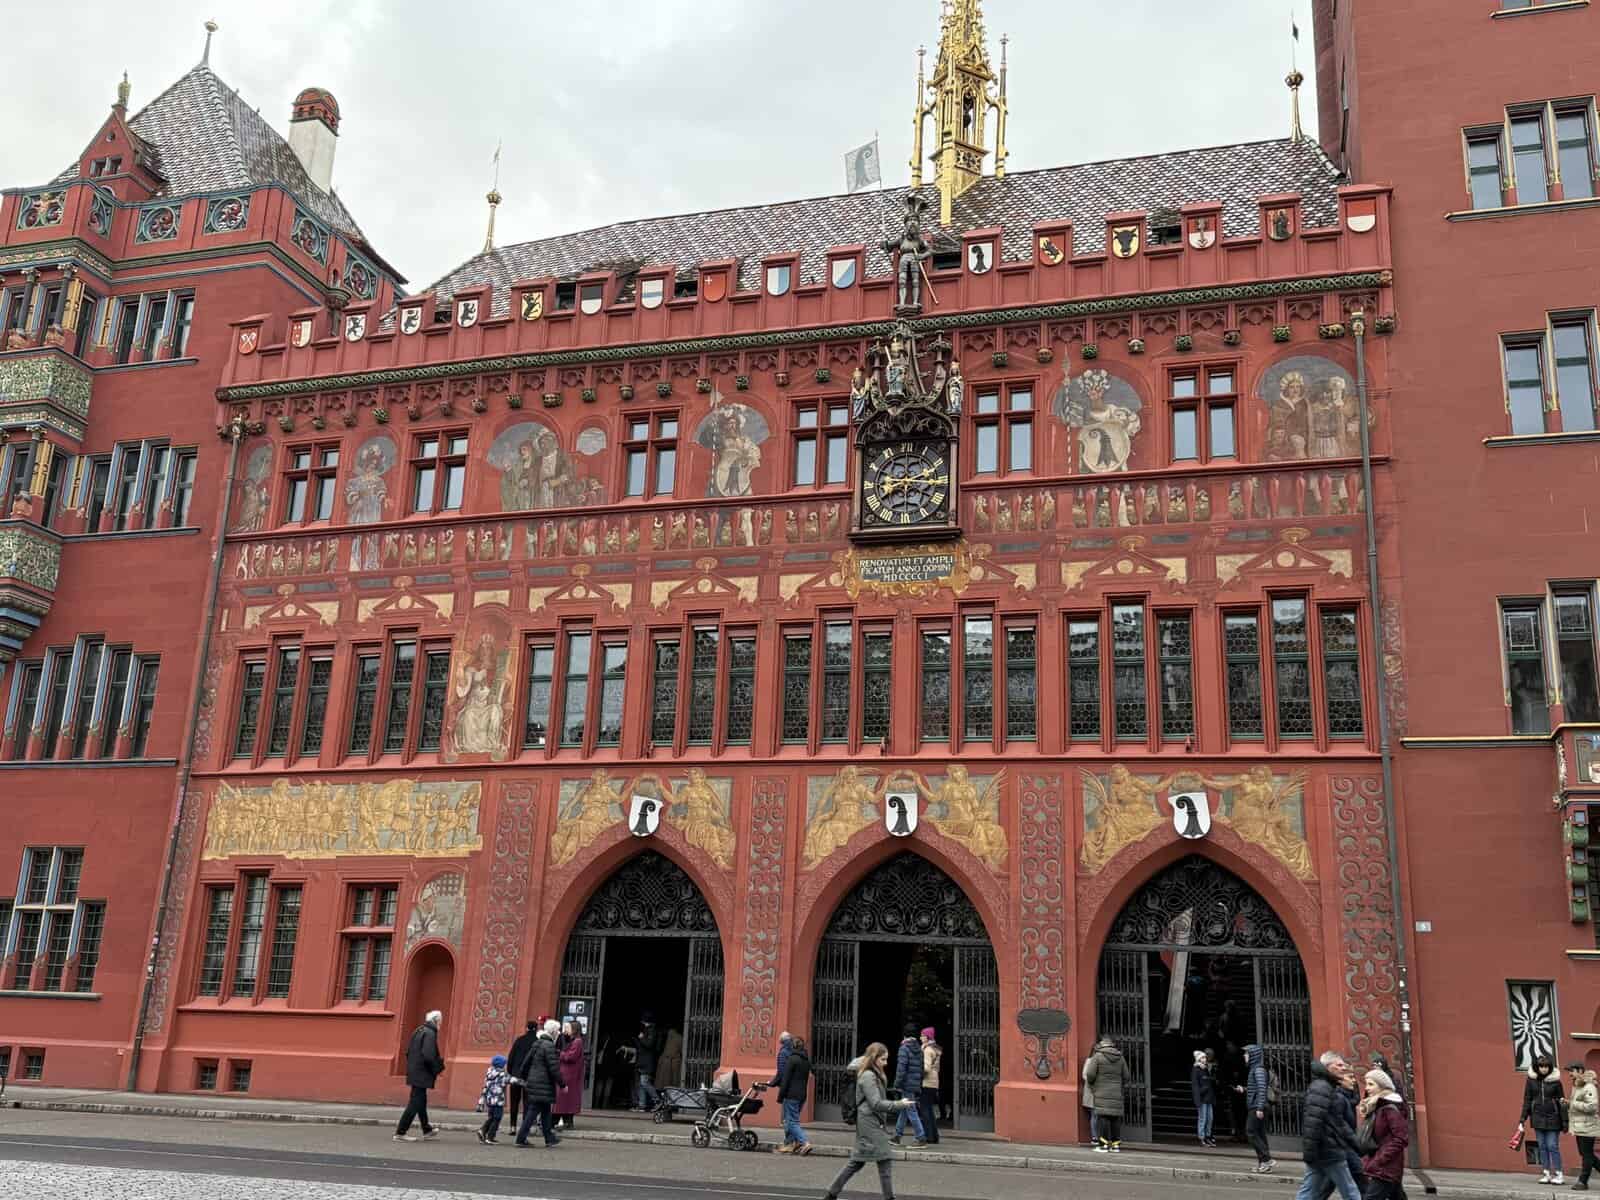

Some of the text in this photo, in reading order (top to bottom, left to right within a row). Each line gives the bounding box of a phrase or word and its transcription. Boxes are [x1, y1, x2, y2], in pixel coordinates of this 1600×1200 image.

[859, 555, 953, 568] RENOVATUM ET AMPLI
[896, 565, 921, 574] ANNO
[922, 564, 951, 573] DOMINI
